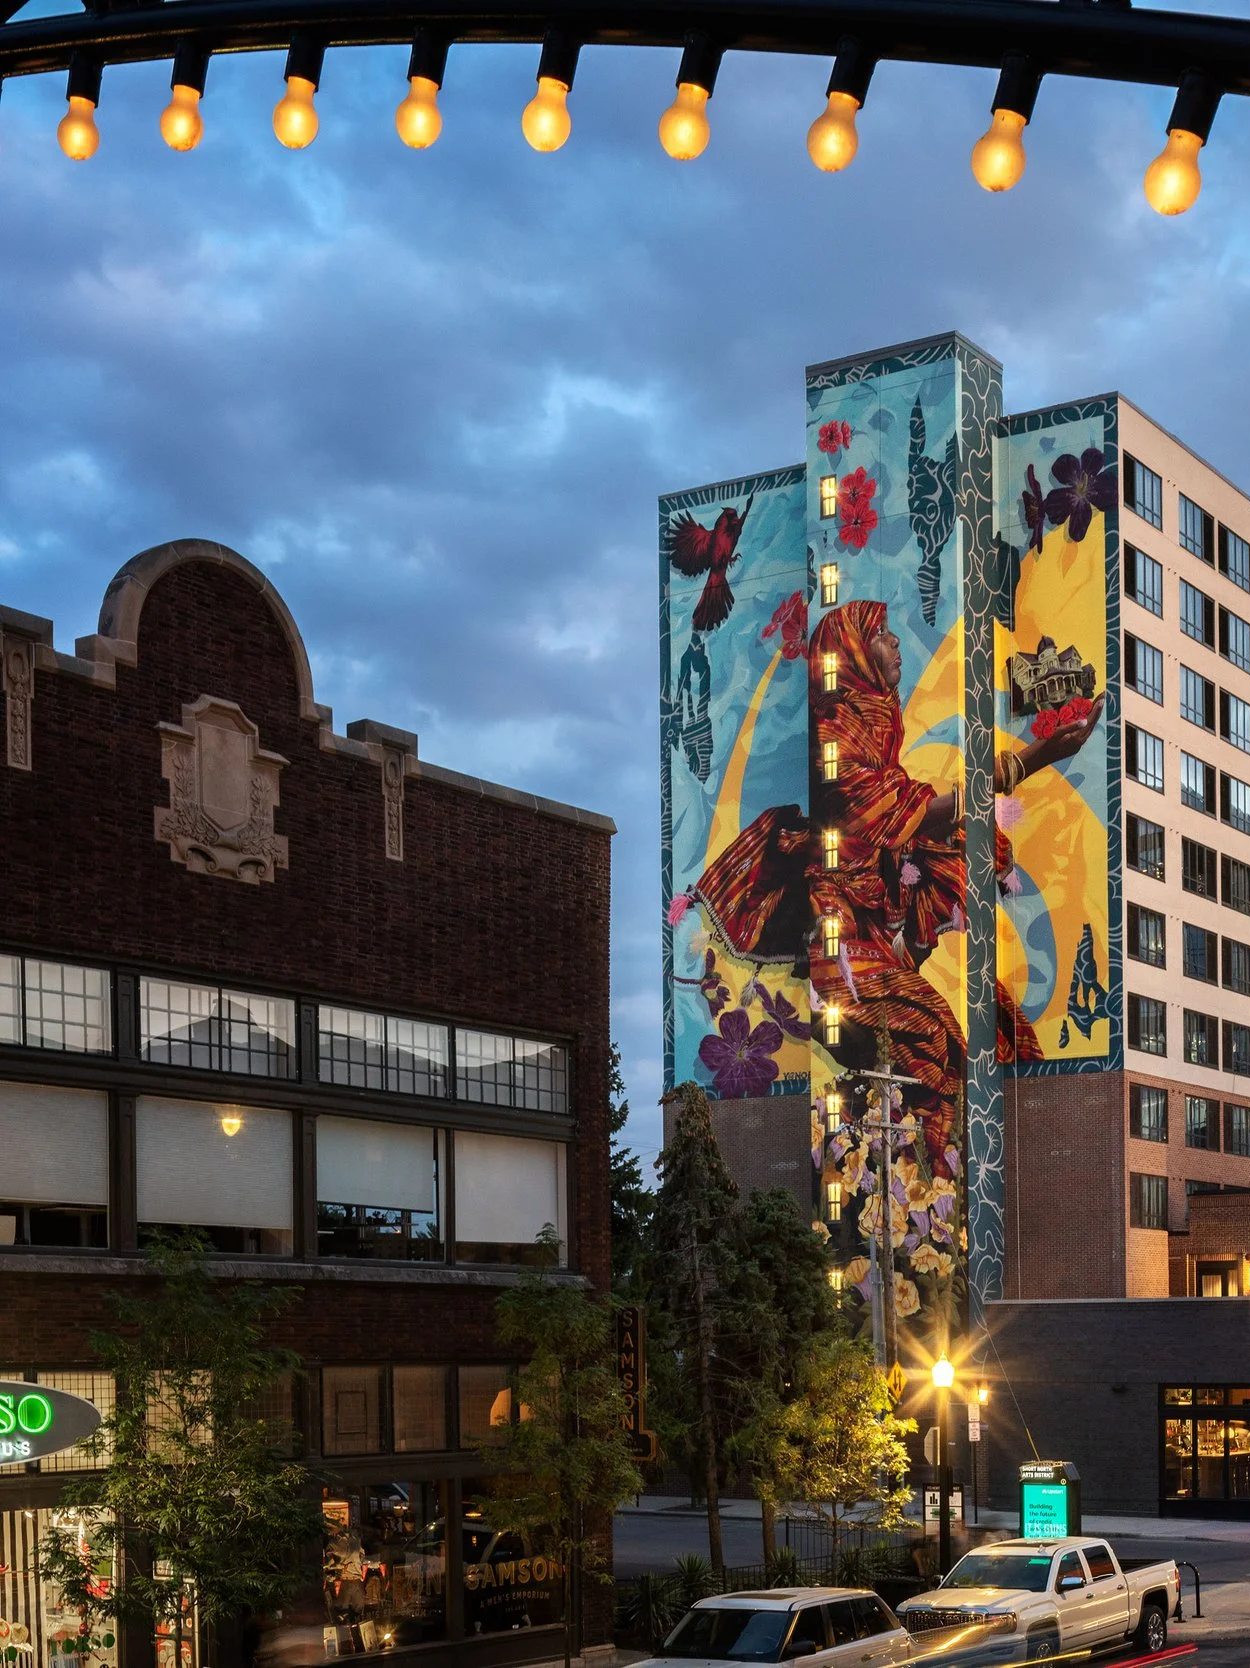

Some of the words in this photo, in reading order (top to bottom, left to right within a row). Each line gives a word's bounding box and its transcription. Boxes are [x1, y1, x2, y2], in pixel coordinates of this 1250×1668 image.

[620, 1310, 635, 1431] SAMSON
[466, 1556, 562, 1591] SAMSON
[512, 1590, 550, 1600] EMPORIUM
